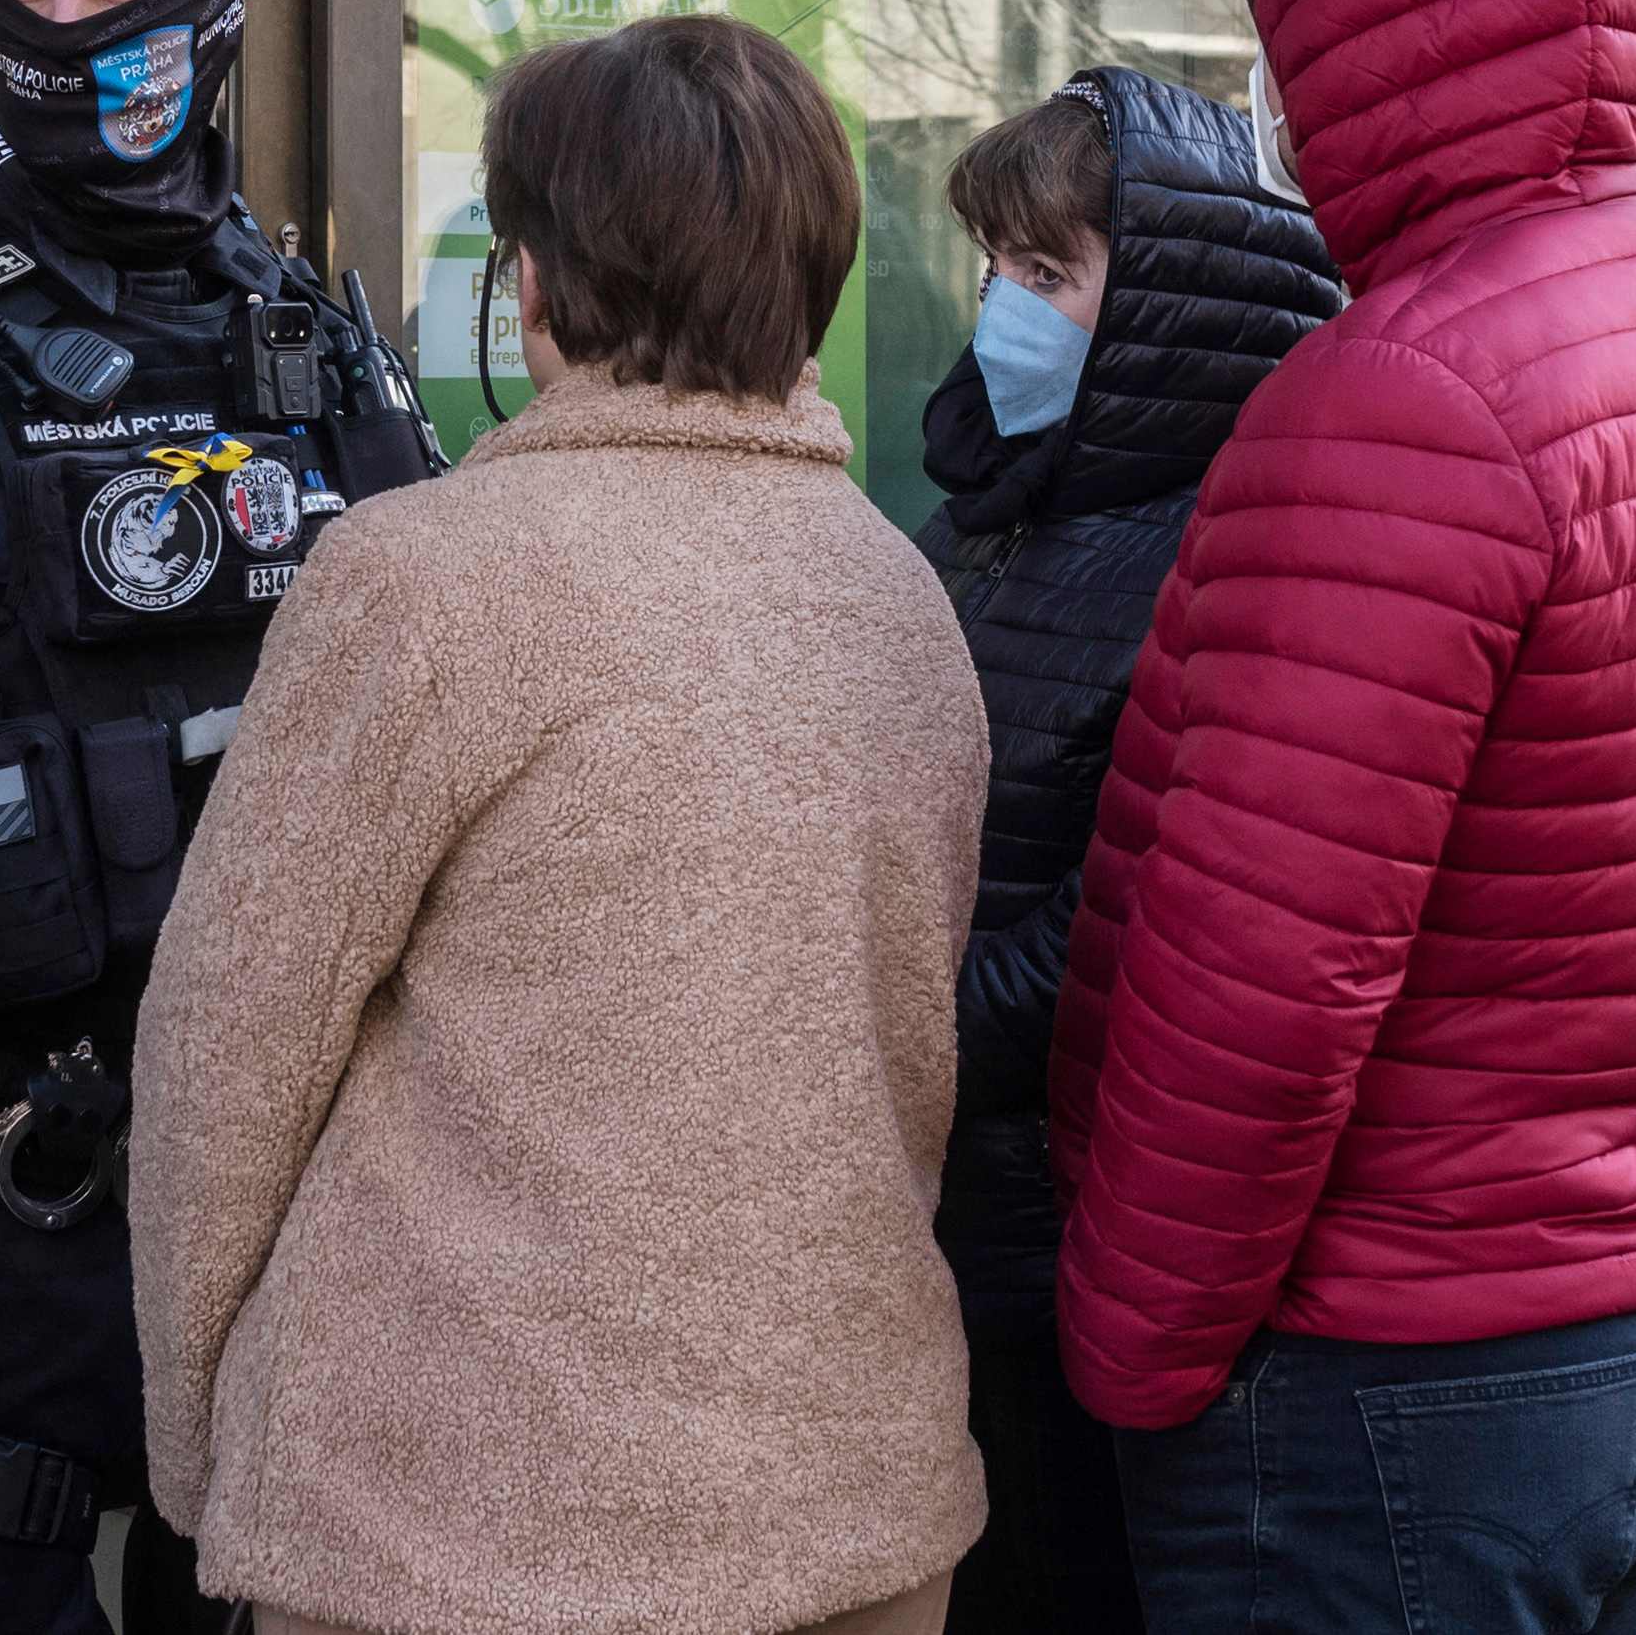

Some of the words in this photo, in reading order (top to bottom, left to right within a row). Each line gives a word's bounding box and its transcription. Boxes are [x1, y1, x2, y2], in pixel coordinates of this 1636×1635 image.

[96, 44, 151, 70] MĚSTSKÁ
[120, 54, 174, 82] PRAHA
[6, 78, 43, 101] PRAHA
[24, 67, 86, 94] POLICIE
[867, 212, 889, 230] UB
[867, 259, 890, 277] SD
[23, 414, 130, 443] MĚSTSKÁ
[98, 471, 157, 507] POLICEJNÍ
[231, 472, 292, 488] POLICIE
[110, 581, 169, 607] MUSADO
[171, 558, 213, 602] BEROUN
